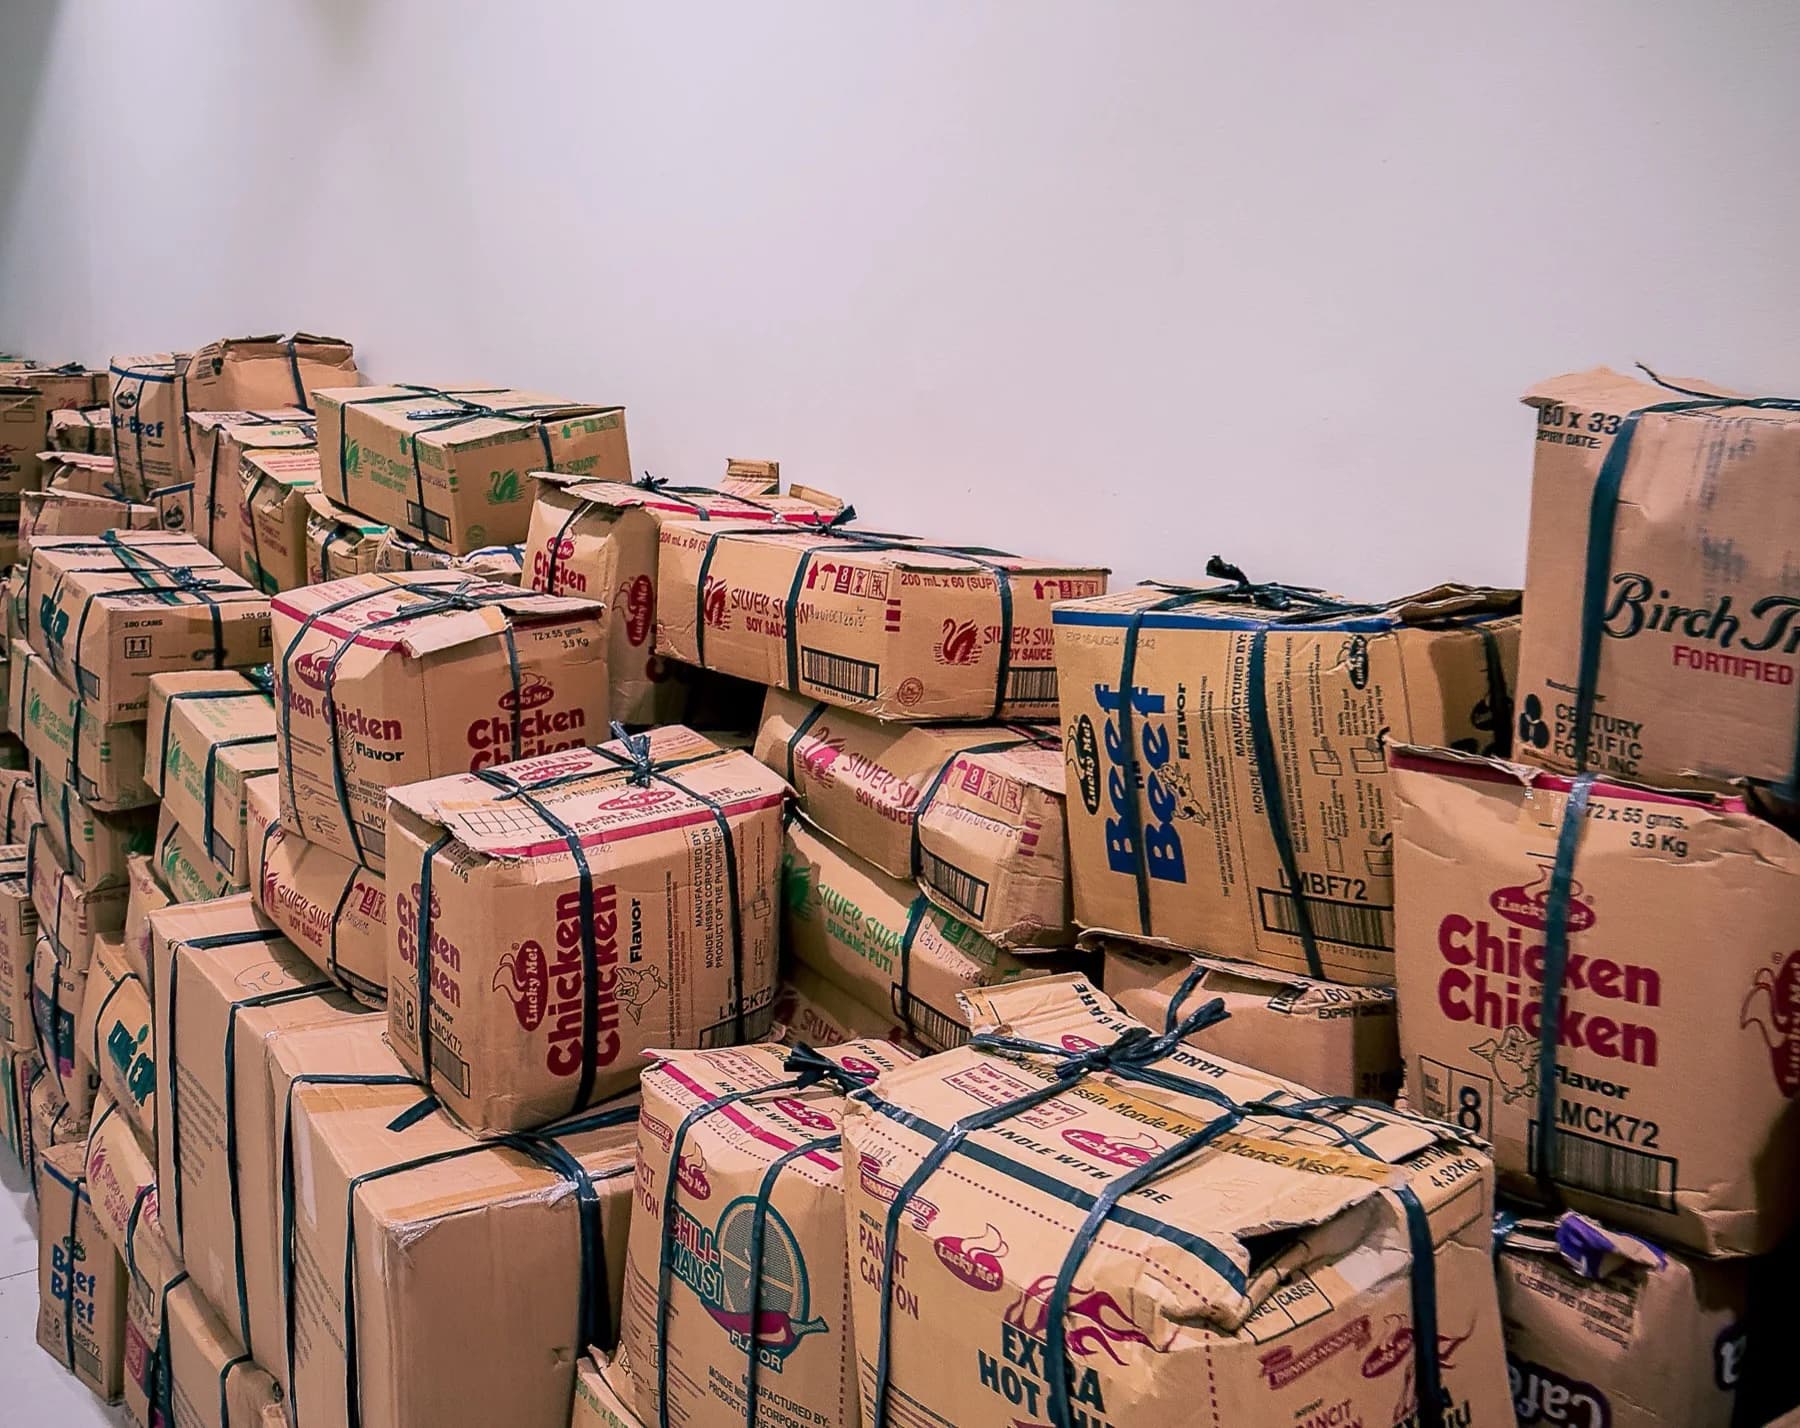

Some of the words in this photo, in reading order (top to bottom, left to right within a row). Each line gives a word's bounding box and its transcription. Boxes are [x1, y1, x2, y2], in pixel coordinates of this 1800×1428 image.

[534, 551, 587, 592] Chcken
[840, 567, 849, 581] 8
[901, 573, 922, 586] 200
[923, 576, 941, 588] mL
[942, 578, 949, 588] x
[951, 577, 965, 589] 60
[967, 577, 998, 593] (SUP)
[731, 587, 769, 617] SILVER
[1604, 573, 1739, 648] Birch
[532, 631, 544, 640] 72
[561, 639, 576, 649] 3.9
[577, 637, 590, 649] Kg
[1022, 647, 1052, 661] SAUCE
[1238, 633, 1248, 662] BY:
[1673, 645, 1793, 685] FORTIFIED
[468, 707, 585, 750] Chcken
[1177, 682, 1190, 760] Flavor
[1231, 663, 1247, 757] MANUFACTURED
[1556, 703, 1643, 739] CETURY
[356, 741, 404, 761] Flavor
[842, 752, 898, 794] SILVER
[970, 767, 980, 784] 8
[1081, 756, 1097, 807] Lucky
[1131, 686, 1187, 884] Beef
[638, 799, 681, 817] WITH
[856, 787, 876, 809] SOY
[876, 799, 914, 826] SAUCE
[1587, 802, 1608, 820] 72
[1608, 809, 1618, 822] x
[1622, 807, 1645, 826] 55
[1646, 811, 1690, 832] gms.
[702, 828, 714, 898] CORPORATION
[713, 826, 726, 886] PHILIPPINES
[1630, 831, 1659, 850] 3.9
[1660, 834, 1689, 858] Kg
[694, 848, 704, 927] MANUFACTURED
[716, 887, 725, 907] THE
[1278, 868, 1368, 900] LBF72
[704, 899, 714, 931] NISSIN
[716, 908, 724, 922] OF
[817, 884, 863, 930] SILVER
[397, 893, 461, 972] Chken
[630, 898, 644, 964] Flavor
[715, 923, 726, 969] PRODUCT
[398, 926, 461, 1008] Chken
[525, 948, 542, 975] Me!
[705, 933, 715, 969] MONDE
[524, 975, 542, 1024] Lucky
[547, 890, 585, 1077] Chicken
[405, 1002, 415, 1031] 8
[1168, 1052, 1230, 1078] HAND
[1112, 1103, 1169, 1129] Monde
[1457, 1085, 1482, 1134] 8
[1554, 1099, 1660, 1149] MCK72
[1055, 1153, 1113, 1181] WITH
[1430, 1157, 1481, 1190] 4.32Kg
[858, 1223, 909, 1280] PANIT
[937, 1242, 973, 1273] Lucky
[973, 1261, 1002, 1288] Me!
[1277, 1282, 1316, 1306] CASES
[978, 1348, 1041, 1418] HOT
[1508, 1365, 1603, 1428] Caf
